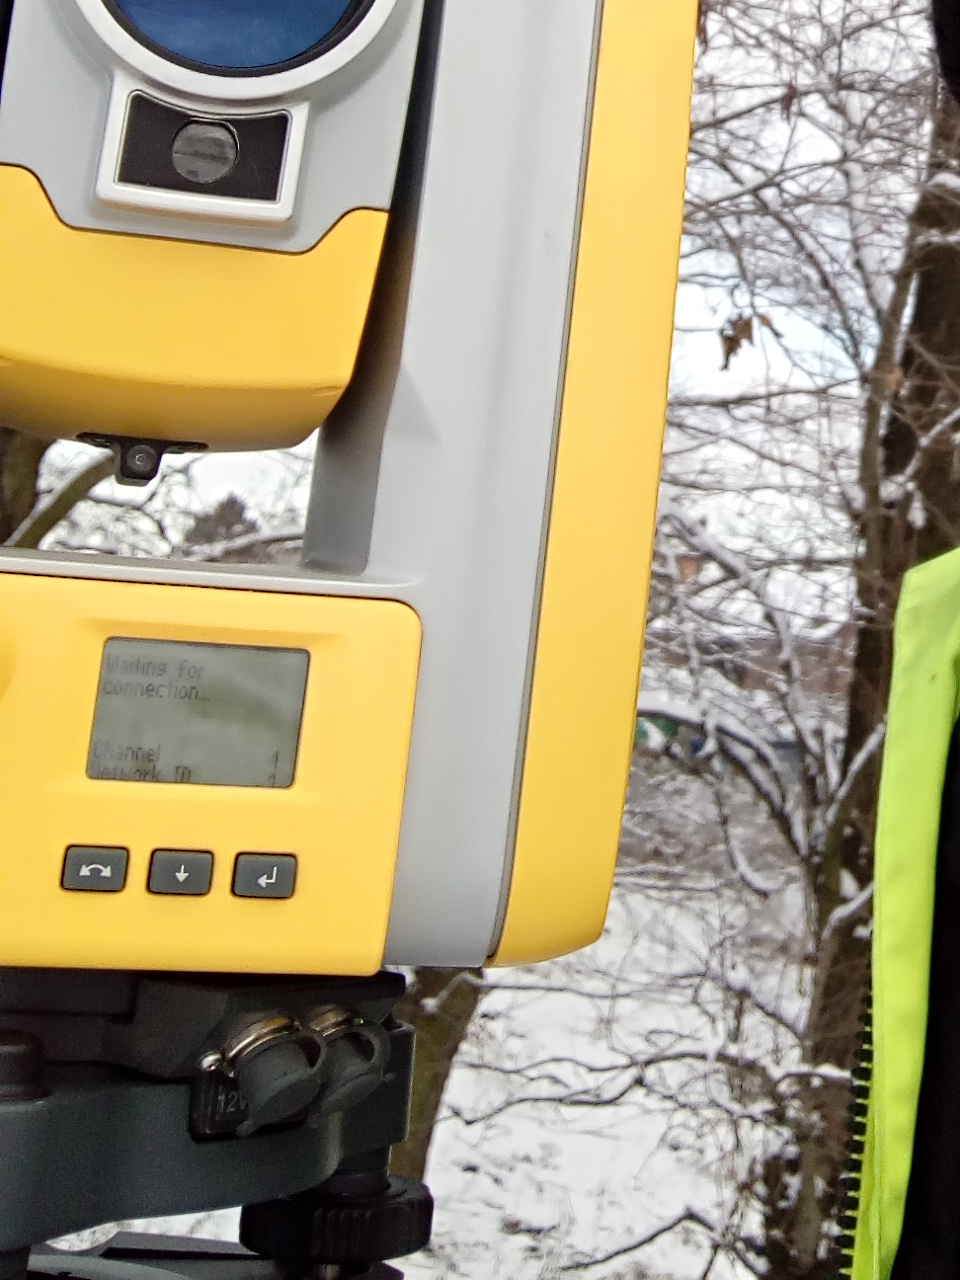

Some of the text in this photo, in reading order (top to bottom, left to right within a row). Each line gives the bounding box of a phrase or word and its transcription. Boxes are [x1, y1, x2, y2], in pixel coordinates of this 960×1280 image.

[178, 659, 207, 679] for
[94, 741, 280, 769] Channel 1
